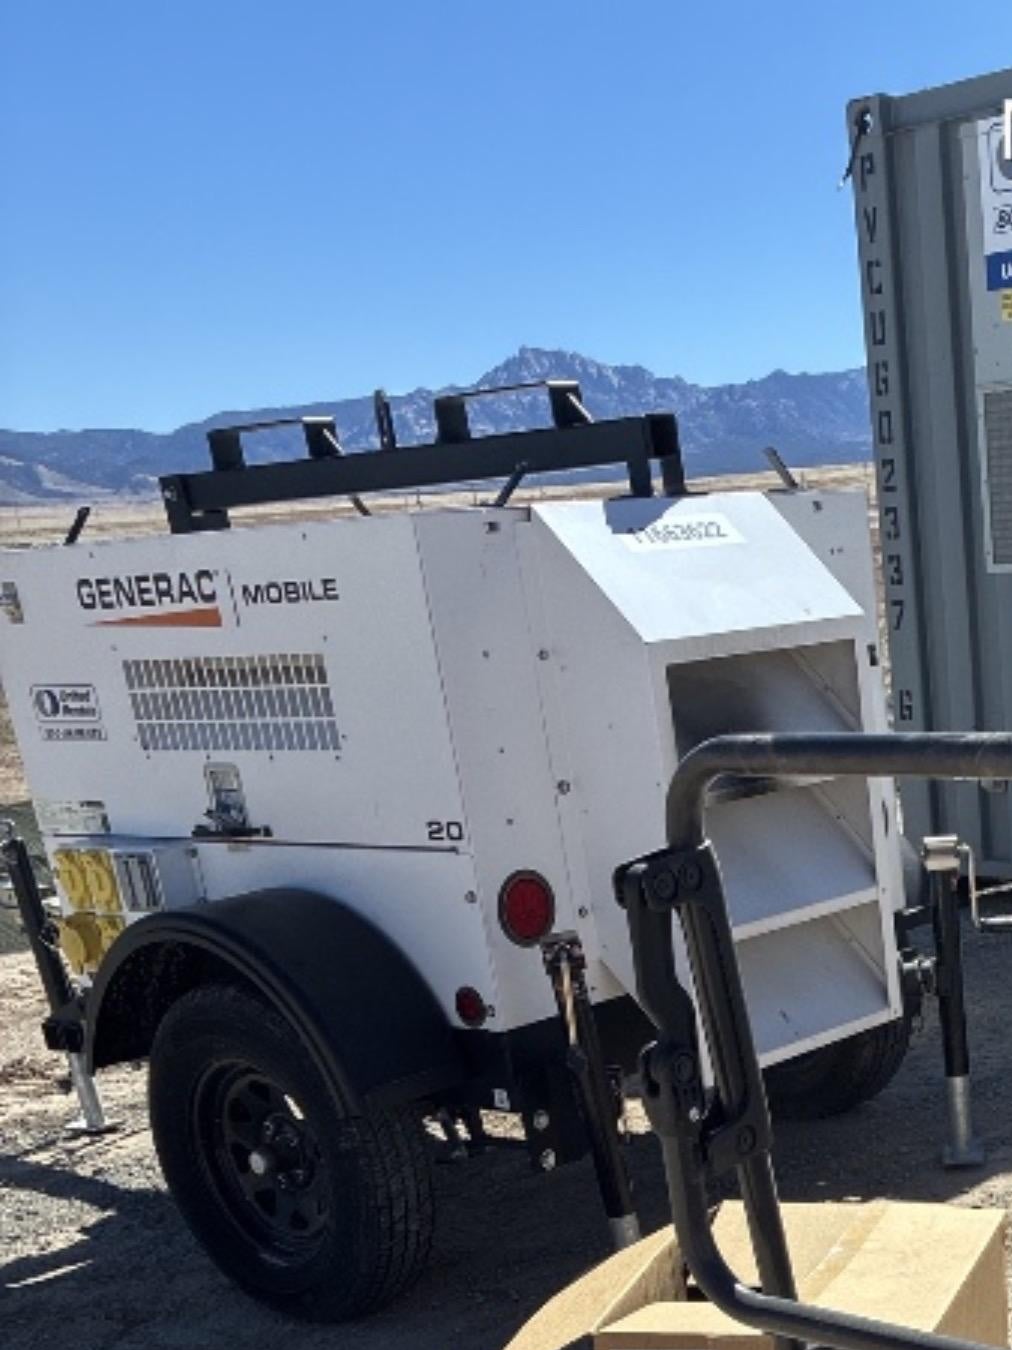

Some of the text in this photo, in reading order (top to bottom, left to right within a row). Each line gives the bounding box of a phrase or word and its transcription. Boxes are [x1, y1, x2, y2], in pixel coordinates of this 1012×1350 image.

[76, 569, 340, 610] GENERAC MOBILE
[426, 821, 464, 841] 20
